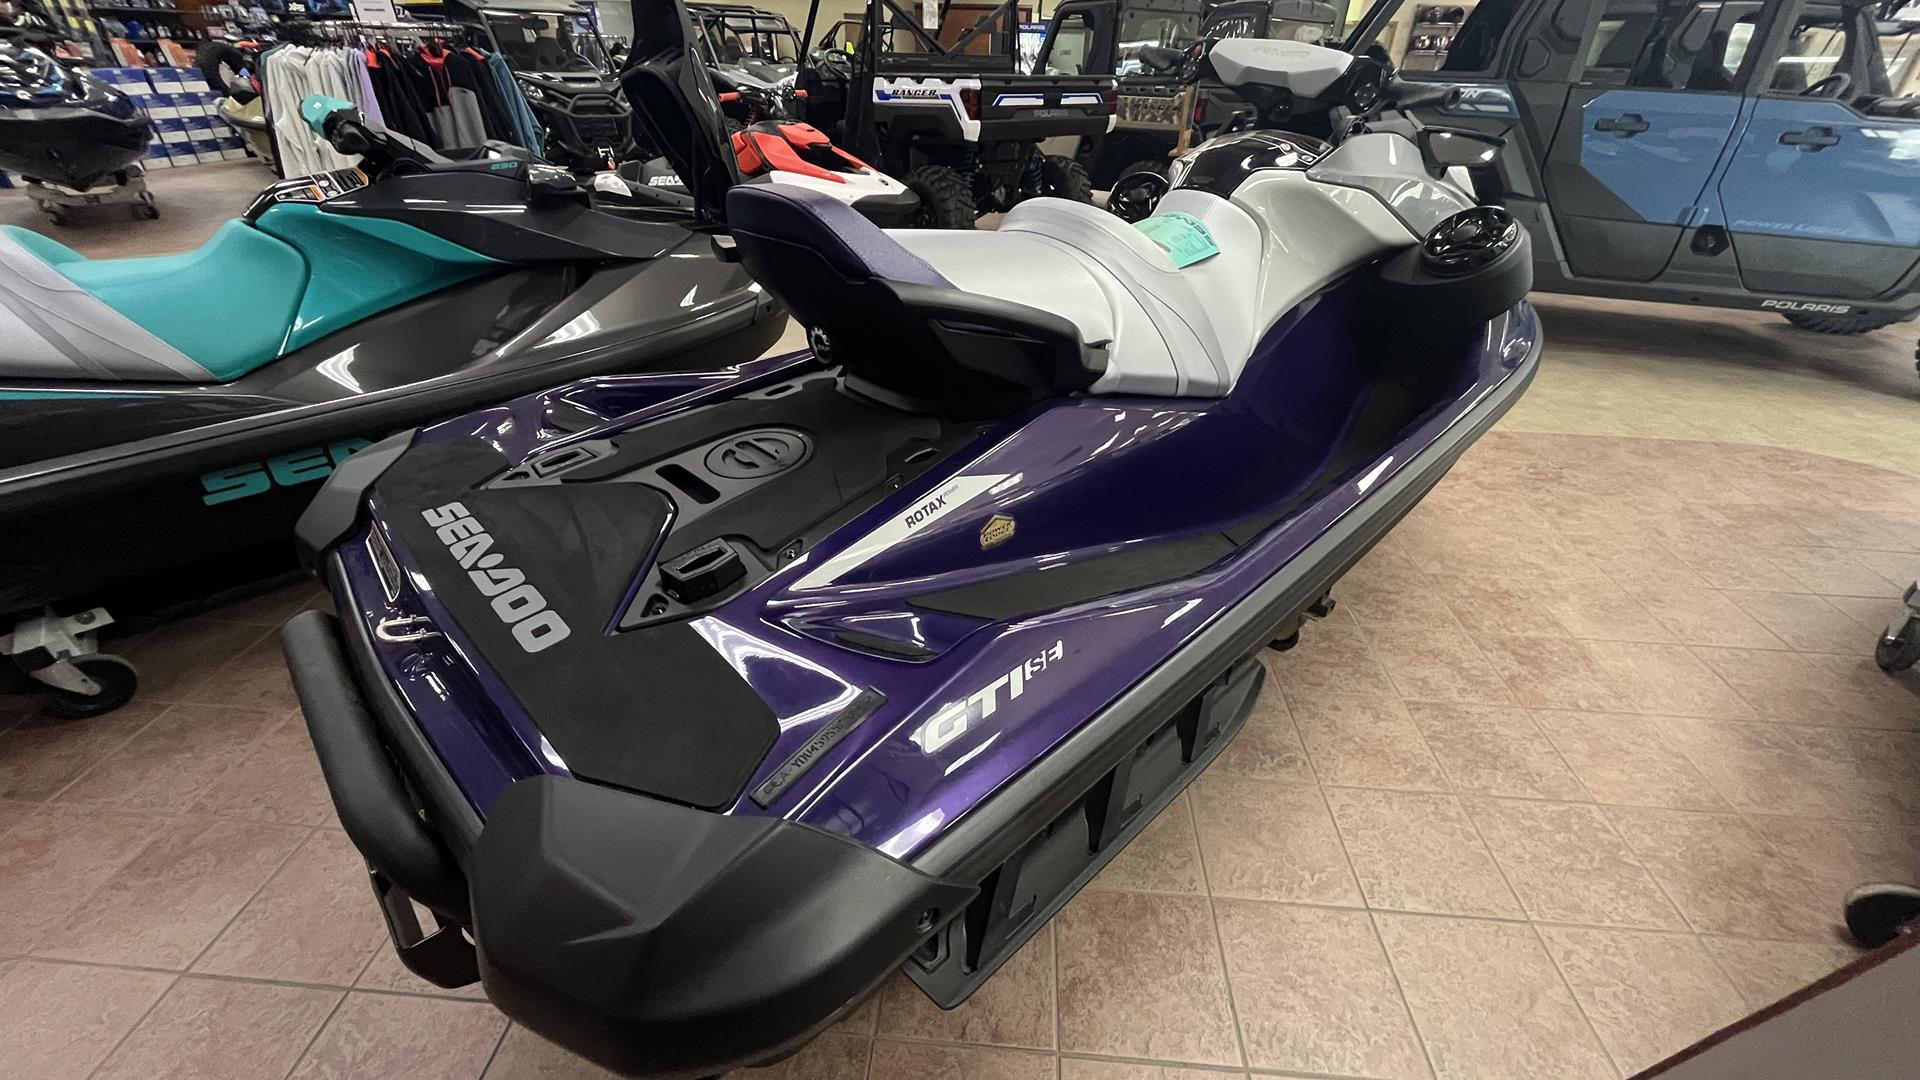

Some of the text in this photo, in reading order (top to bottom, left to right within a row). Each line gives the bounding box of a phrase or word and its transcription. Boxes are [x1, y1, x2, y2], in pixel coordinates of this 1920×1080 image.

[490, 161, 518, 171] 230
[1760, 299, 1851, 314] POLARIS
[905, 495, 947, 528] ROTAX
[983, 522, 1012, 538] POWER
[985, 527, 1010, 542] LODGE
[924, 665, 1024, 754] GTI
